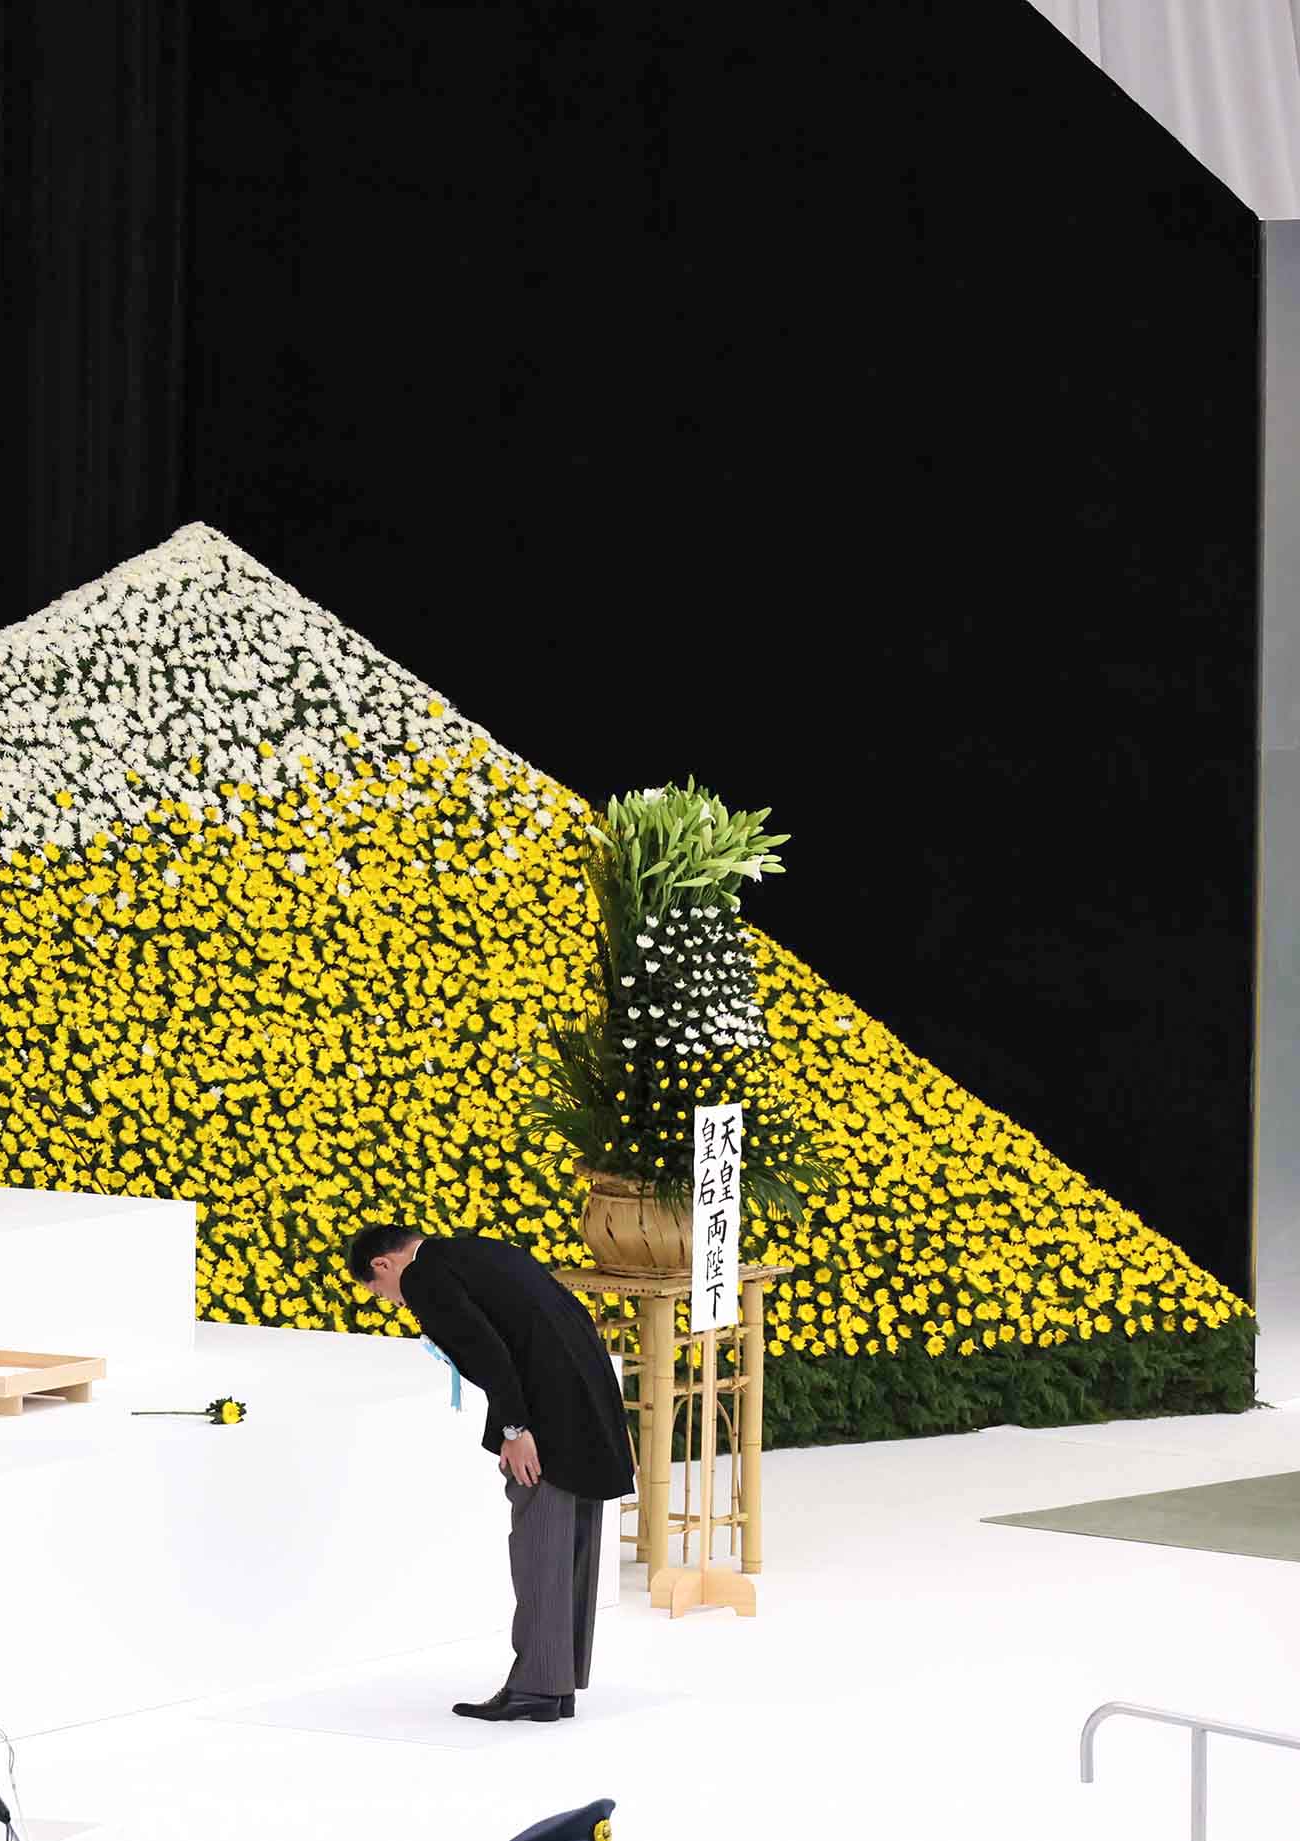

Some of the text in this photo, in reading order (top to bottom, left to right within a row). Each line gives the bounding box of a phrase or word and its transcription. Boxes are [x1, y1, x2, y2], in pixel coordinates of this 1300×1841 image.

[697, 1117, 717, 1207] 皇后
[718, 1115, 739, 1204] 天皇
[706, 1209, 727, 1321] 両陛下
